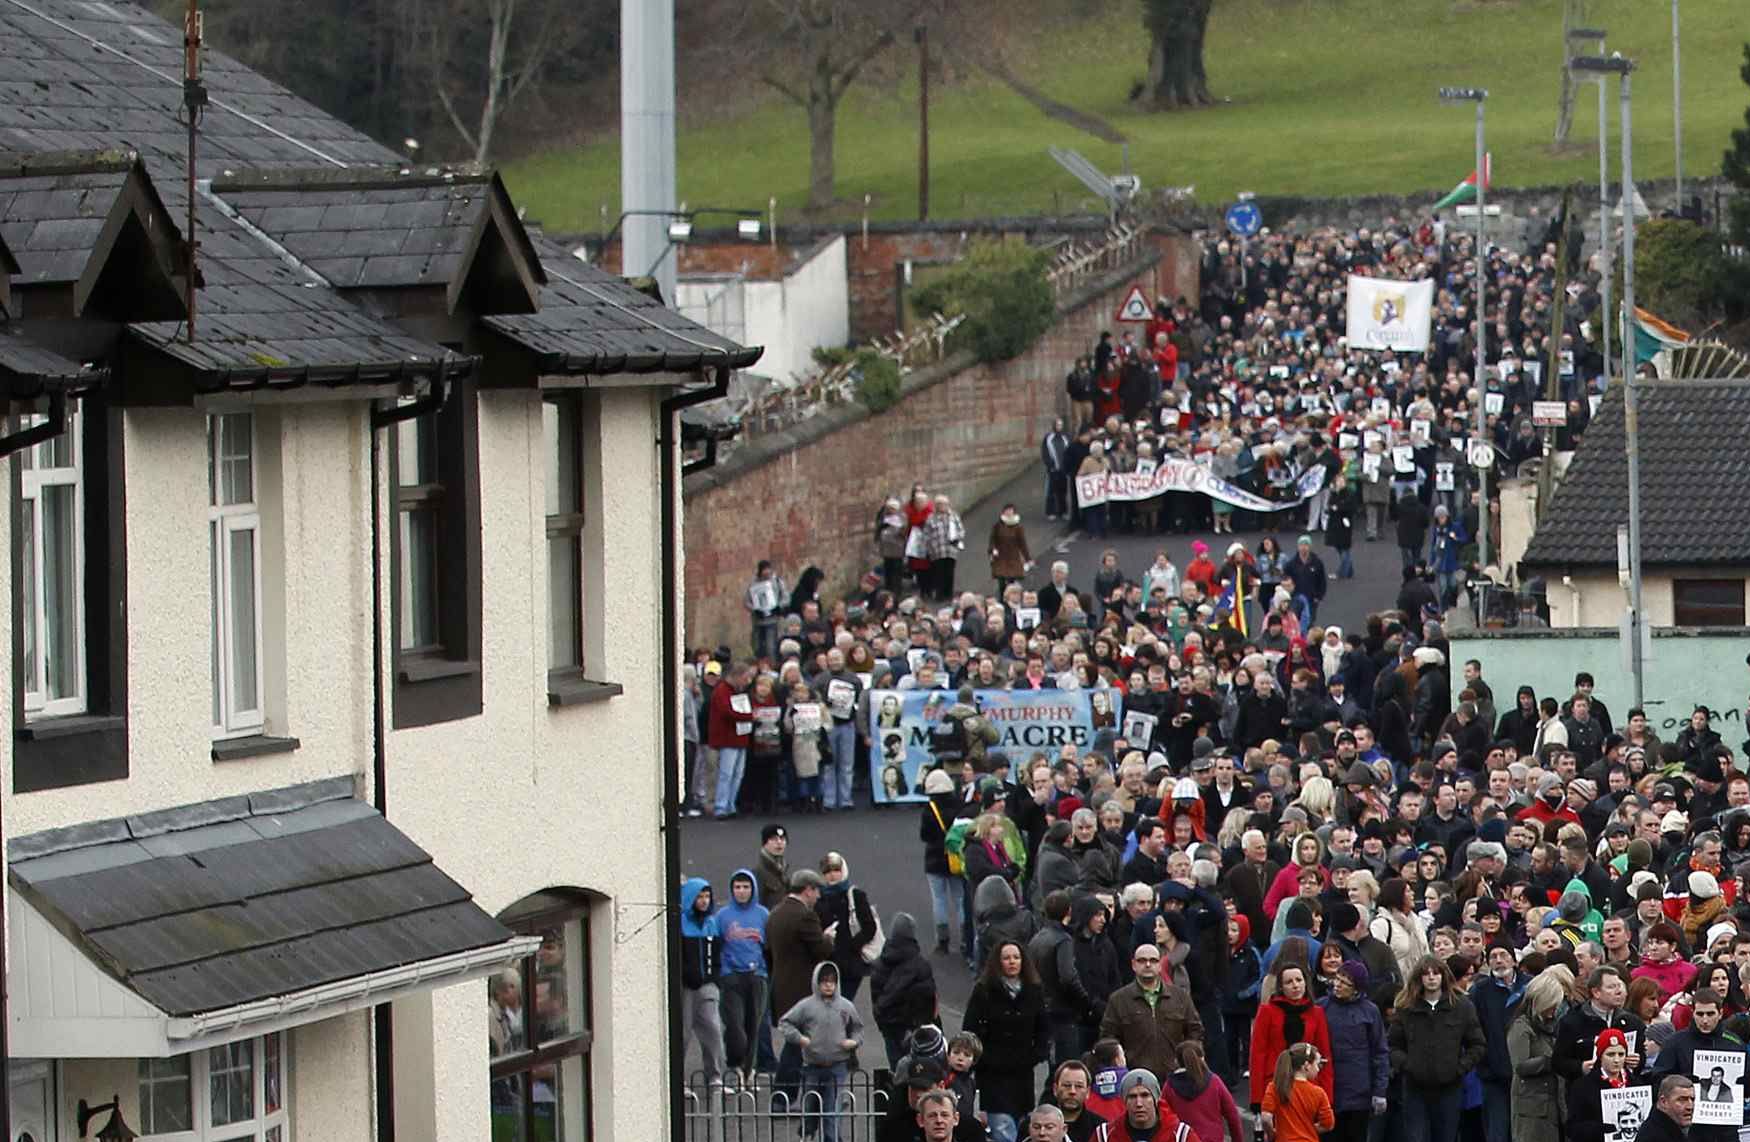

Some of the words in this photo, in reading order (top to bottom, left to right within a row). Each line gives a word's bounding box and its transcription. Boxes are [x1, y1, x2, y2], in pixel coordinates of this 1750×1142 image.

[909, 725, 1089, 748] MACRE
[1696, 1054, 1742, 1064] VINDICATED
[1603, 1090, 1649, 1100] VINDICATED
